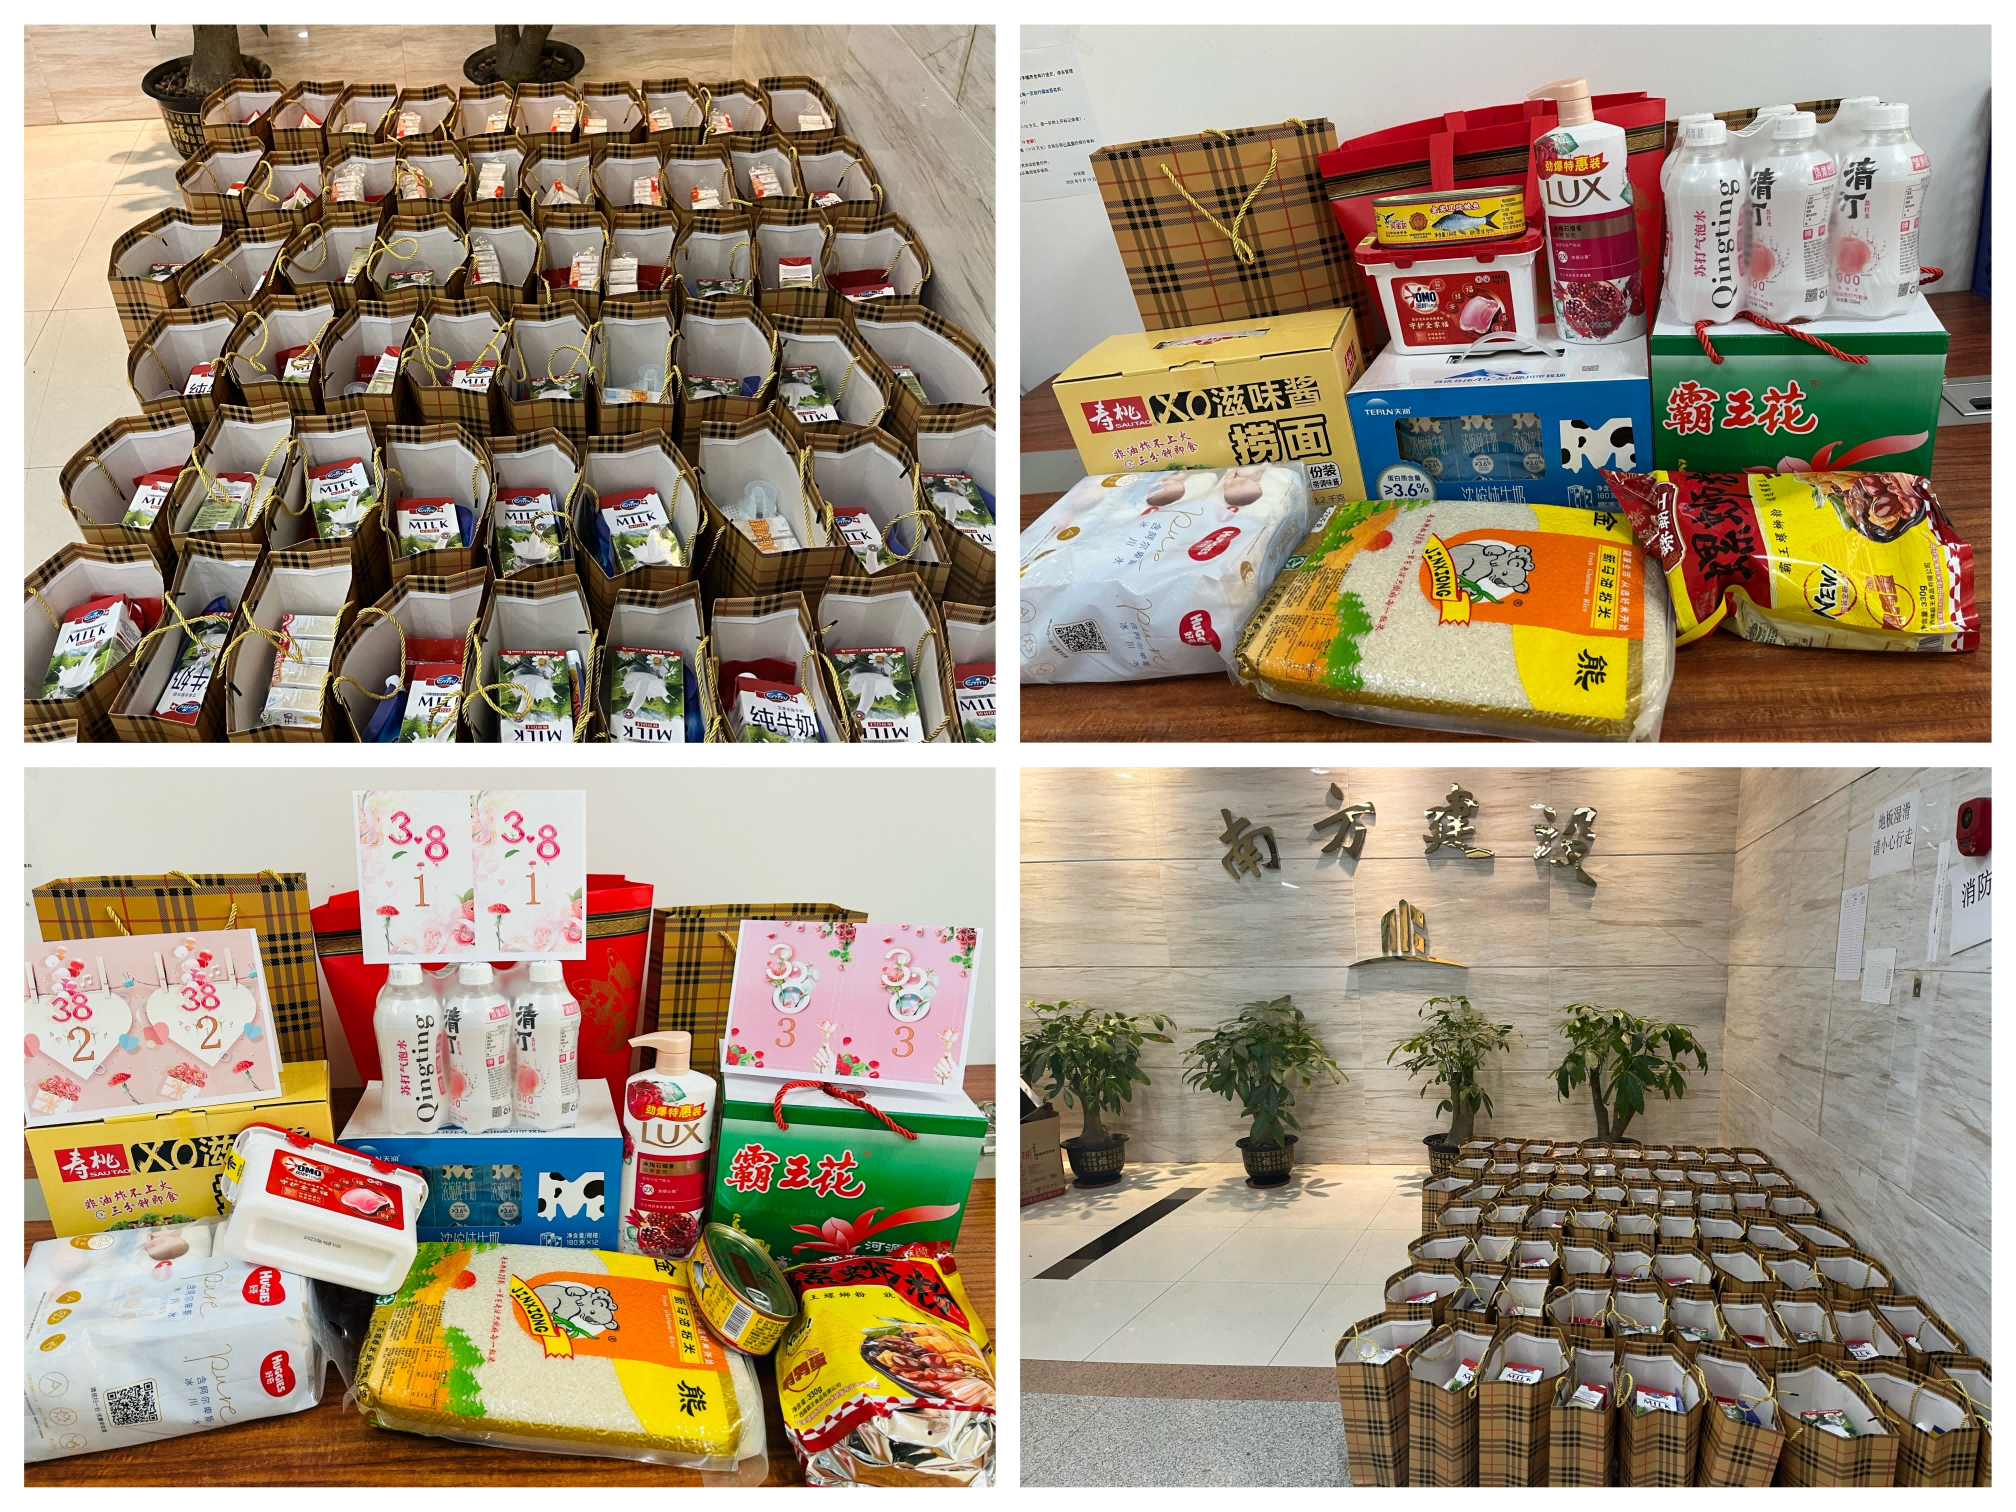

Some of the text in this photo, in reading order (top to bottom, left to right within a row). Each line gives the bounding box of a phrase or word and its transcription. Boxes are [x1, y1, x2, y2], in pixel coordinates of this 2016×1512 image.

[1545, 155, 1601, 173] 劲爆特惠装
[1546, 177, 1611, 208] LUX
[1693, 210, 1707, 277] 苏打气泡水
[1711, 178, 1741, 309] Qingting
[1415, 291, 1436, 302] OMO
[1151, 375, 1321, 424] XO滋味酱
[1663, 380, 1818, 436] 霸王花
[1089, 400, 1142, 431] 寿桃
[1115, 419, 1151, 430] SAUTAO
[1113, 430, 1193, 461] 非油炸不上火
[1138, 441, 1200, 467] 三分钟即食
[1228, 413, 1333, 466] 捞面
[319, 479, 358, 494] MILK
[1309, 463, 1337, 479] 份装
[1387, 474, 1421, 482] 蛋白质含量
[1383, 482, 1429, 497] ≥3.6%
[408, 519, 449, 530] MILK
[505, 511, 545, 521] MILK
[616, 512, 657, 527] MILK
[1593, 511, 1618, 532] 金
[845, 531, 873, 543] ILK
[1424, 547, 1452, 599] JINXIONG
[1582, 598, 1590, 613] Rice
[1811, 563, 1838, 620] NEW!
[66, 624, 107, 644] MILK
[1574, 649, 1608, 692] 熊
[514, 729, 562, 742] MILK
[623, 725, 672, 742] MILK
[749, 706, 817, 738] 纯牛奶
[1878, 801, 1912, 830] 地板湿滑
[1220, 782, 1598, 887] 南方建设
[1873, 827, 1914, 856] 请小心行走
[413, 873, 431, 907] 1
[525, 872, 541, 905] 1
[1961, 868, 1993, 909] 消防
[51, 993, 93, 1023] 38
[181, 983, 221, 1012] 38
[68, 1026, 95, 1062] 2
[196, 1015, 222, 1050] 2
[775, 1017, 796, 1048] 3
[891, 1026, 915, 1058] 3
[396, 1040, 412, 1097] 苏打气泡水
[411, 1014, 438, 1122] Qingting
[645, 1104, 703, 1118] 劲爆特惠装
[641, 1121, 704, 1149] LUX
[62, 1148, 121, 1180] 寿桃
[131, 1133, 238, 1173] XO滋
[90, 1168, 131, 1178] SAUTAO
[297, 1164, 322, 1178] OMO
[725, 1143, 866, 1199] 霸王花
[84, 1180, 173, 1211] 非油炸不上火
[112, 1191, 179, 1217] 三分钟即食
[653, 1258, 676, 1279] 金
[259, 1270, 273, 1304] HUGGIES
[511, 1286, 549, 1334] JINXIONG
[183, 1343, 236, 1423] pure
[264, 1370, 274, 1385] 好奇
[271, 1353, 286, 1394] HUGGIES
[1506, 1373, 1532, 1383] MILK
[677, 1379, 707, 1418] 熊
[1644, 1398, 1671, 1410] MILK
